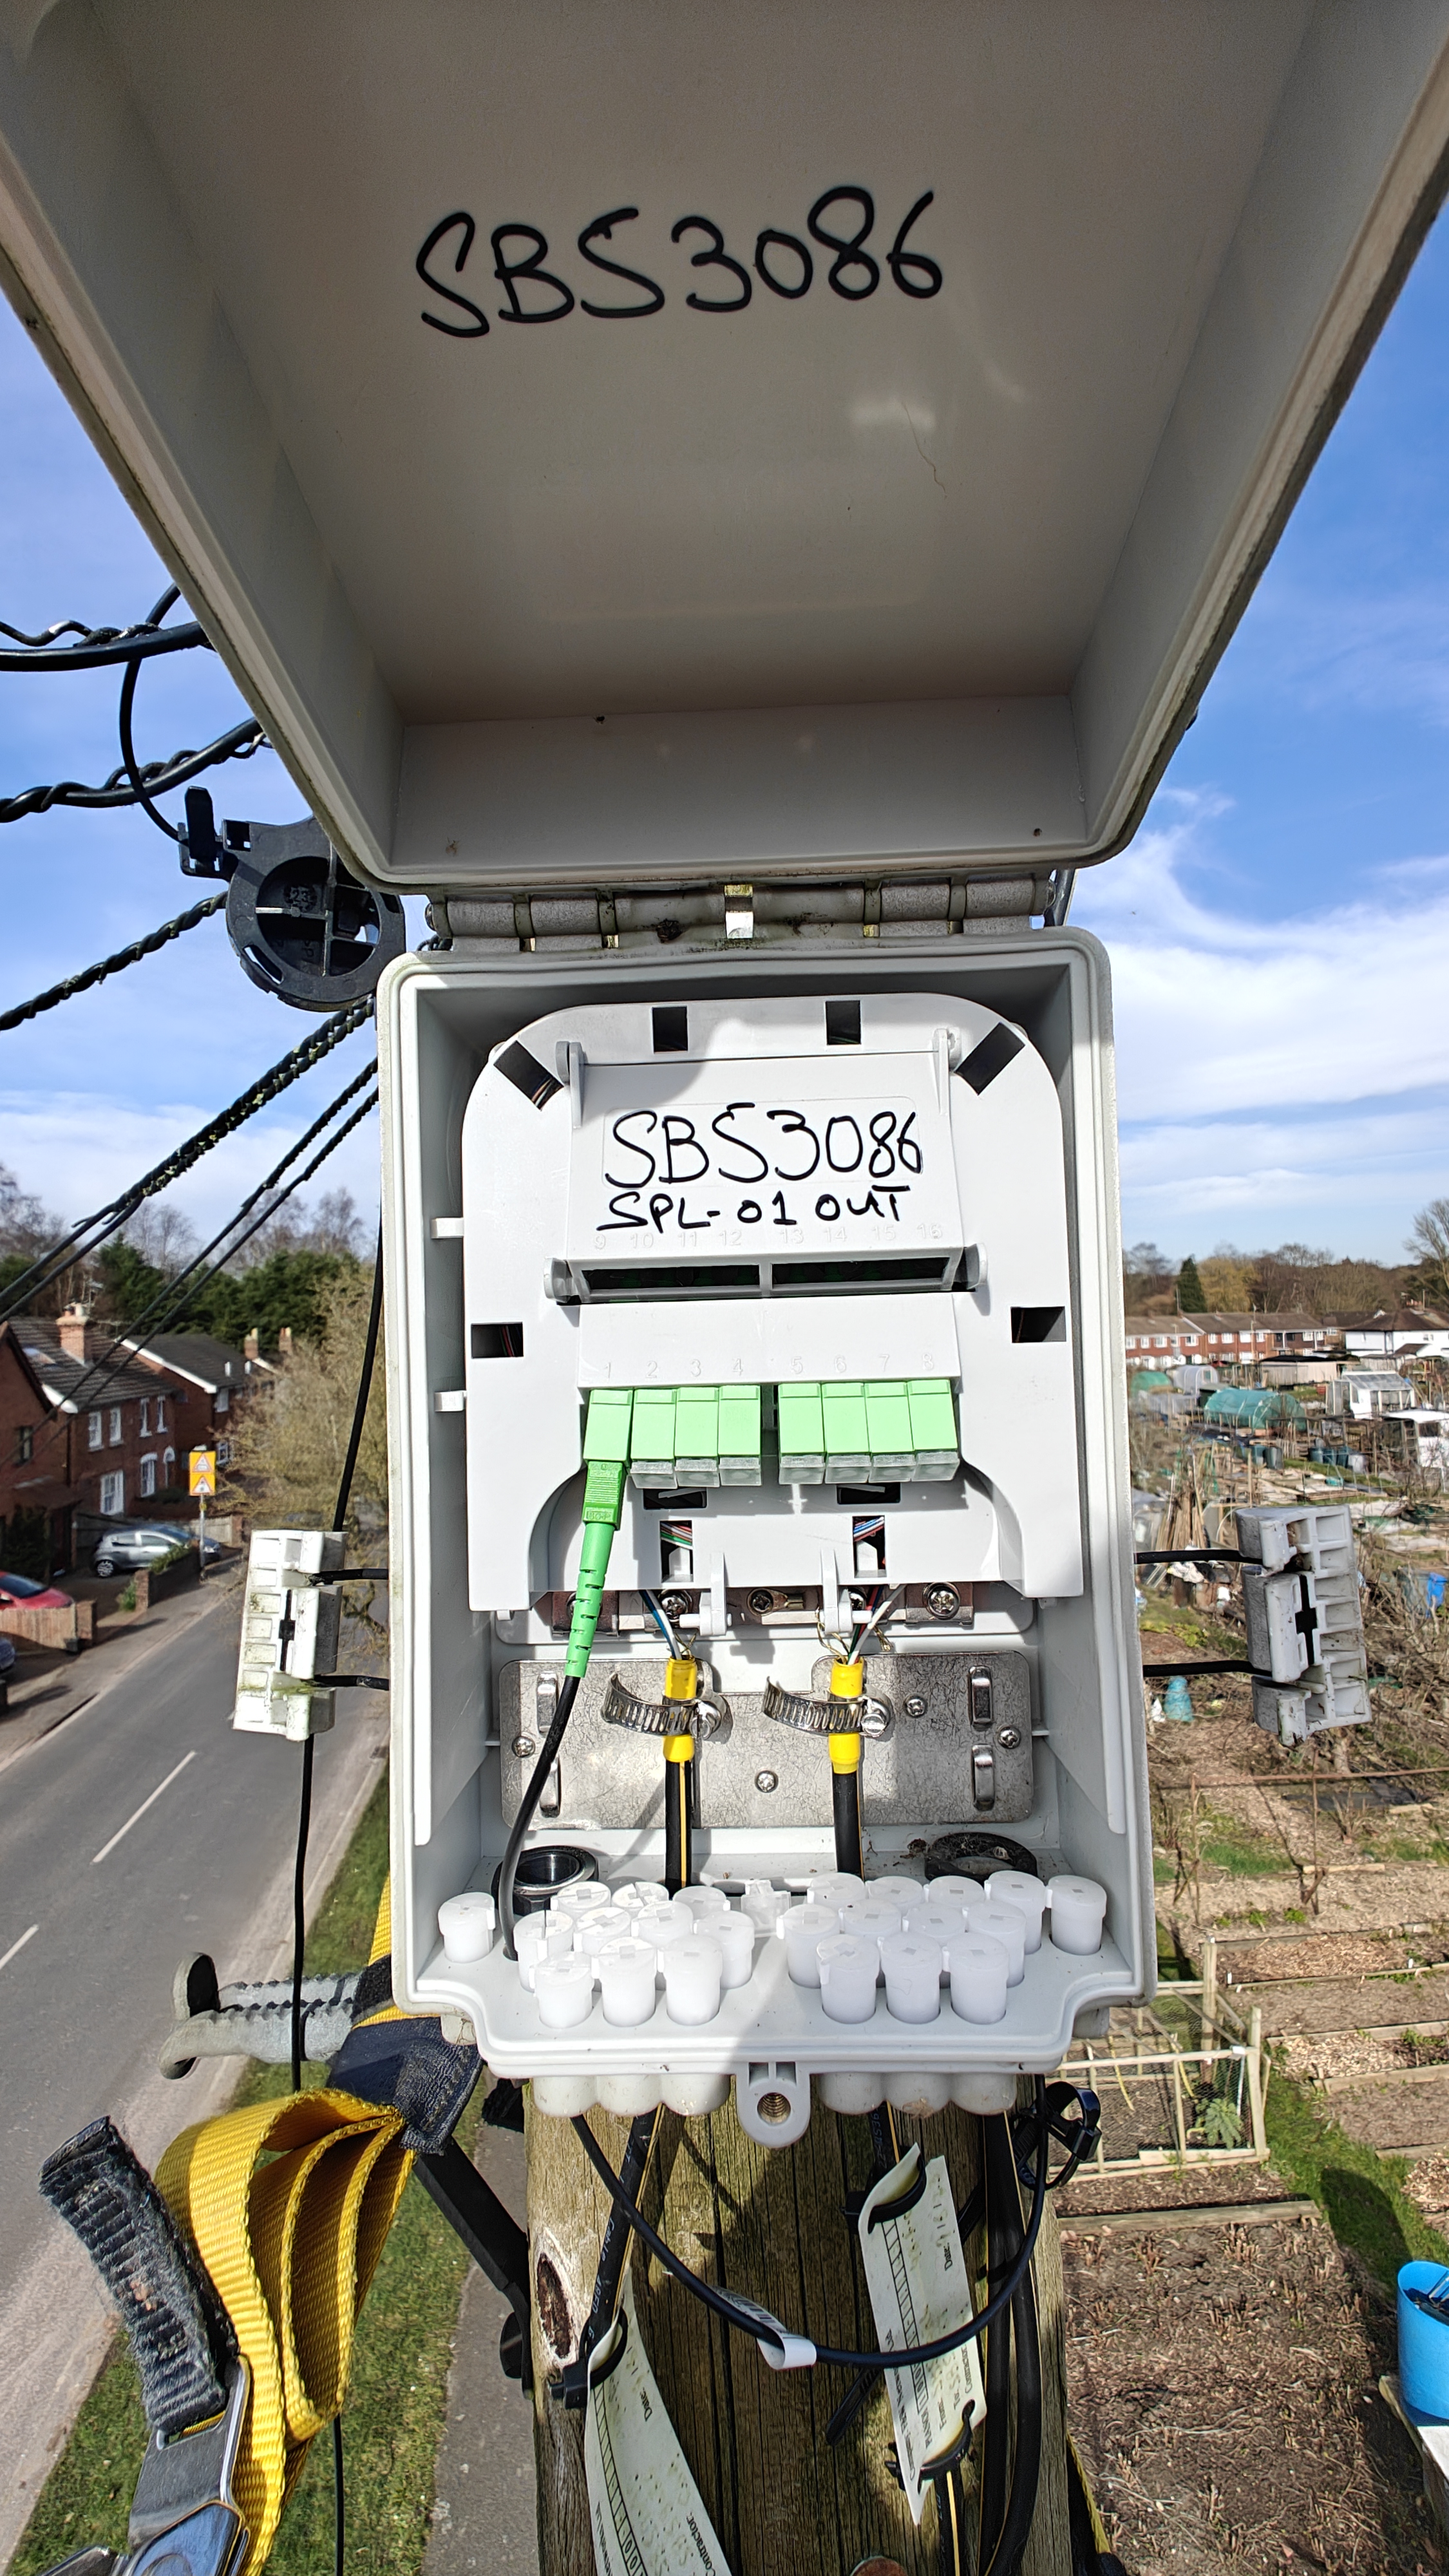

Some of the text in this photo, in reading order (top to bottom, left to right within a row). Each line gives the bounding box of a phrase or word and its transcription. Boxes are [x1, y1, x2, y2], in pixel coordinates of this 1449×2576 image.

[416, 186, 942, 337] SBS3086
[605, 1102, 922, 1188] SBS3086
[815, 1184, 911, 1221] OUT
[593, 1224, 942, 1250] 9 10 11 12 13 14 15 16
[603, 1354, 933, 1378] 1 2 3 4 5 6 7 8
[944, 2242, 952, 2271] Date:
[640, 2387, 652, 2421] Date:
[938, 2398, 947, 2430] From:
